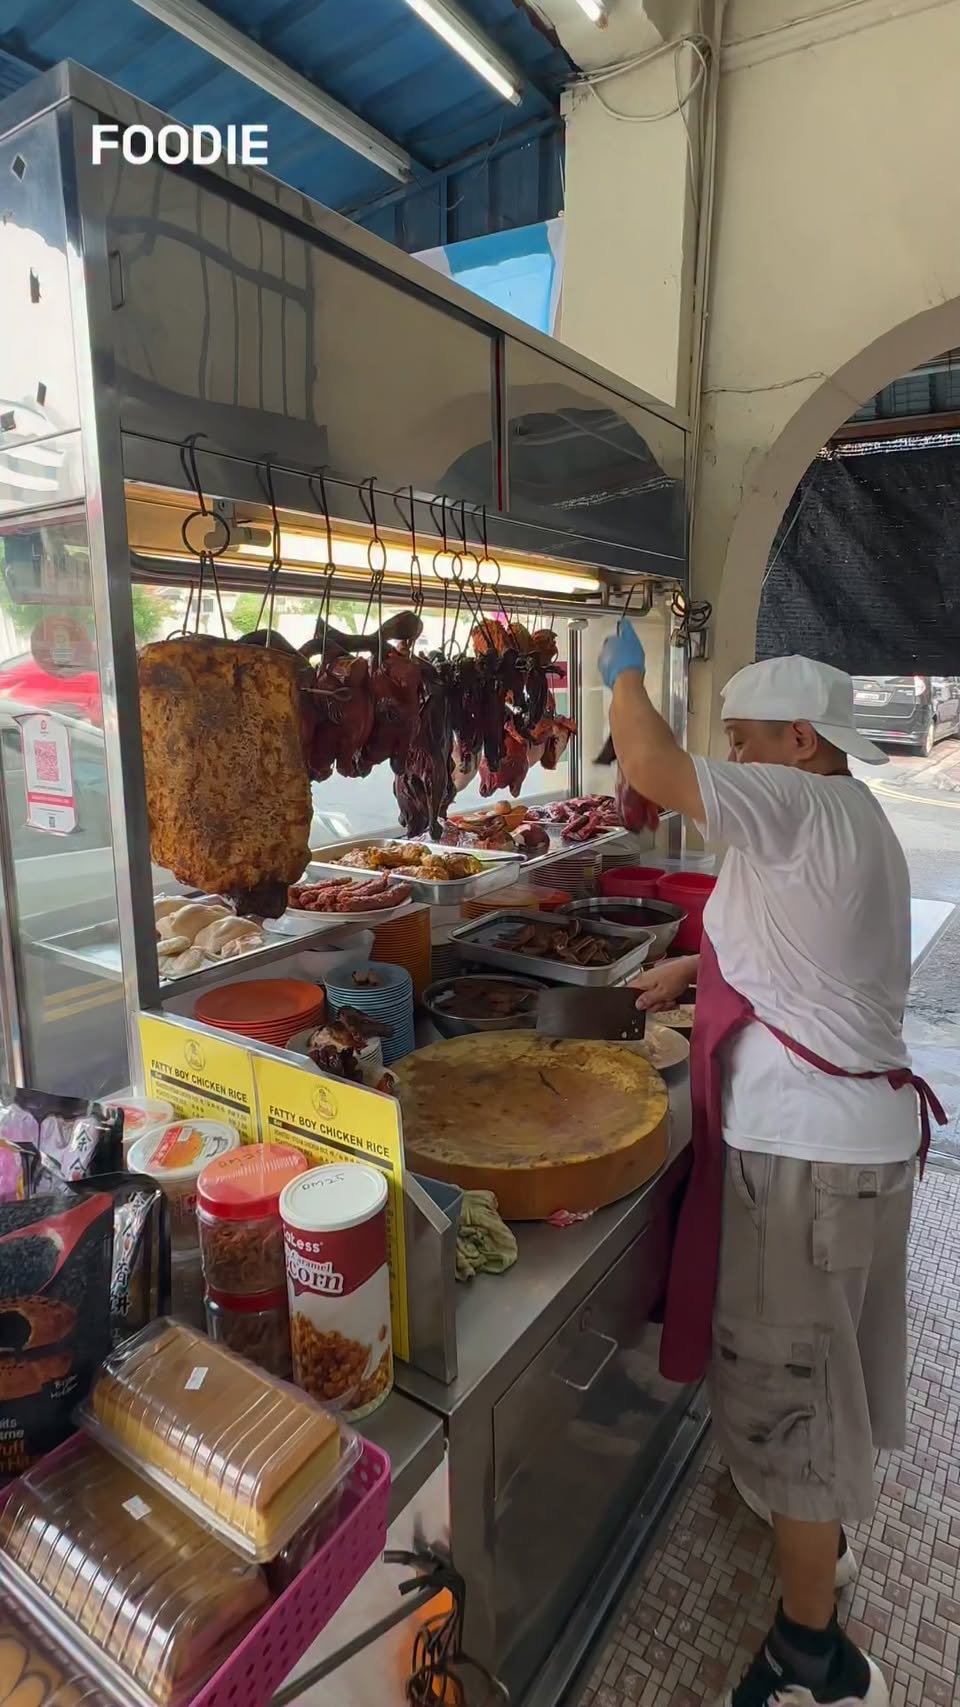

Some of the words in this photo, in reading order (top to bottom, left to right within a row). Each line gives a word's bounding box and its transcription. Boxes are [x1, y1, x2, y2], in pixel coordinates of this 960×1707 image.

[151, 1059, 173, 1075] FATTY
[174, 1071, 189, 1081] BOY
[191, 1074, 226, 1095] CHICKEN
[228, 1088, 248, 1103] RICE
[269, 1106, 296, 1122] FATTY
[298, 1116, 317, 1131] BOY
[320, 1124, 363, 1148] CHICKEN
[366, 1139, 390, 1158] RICE
